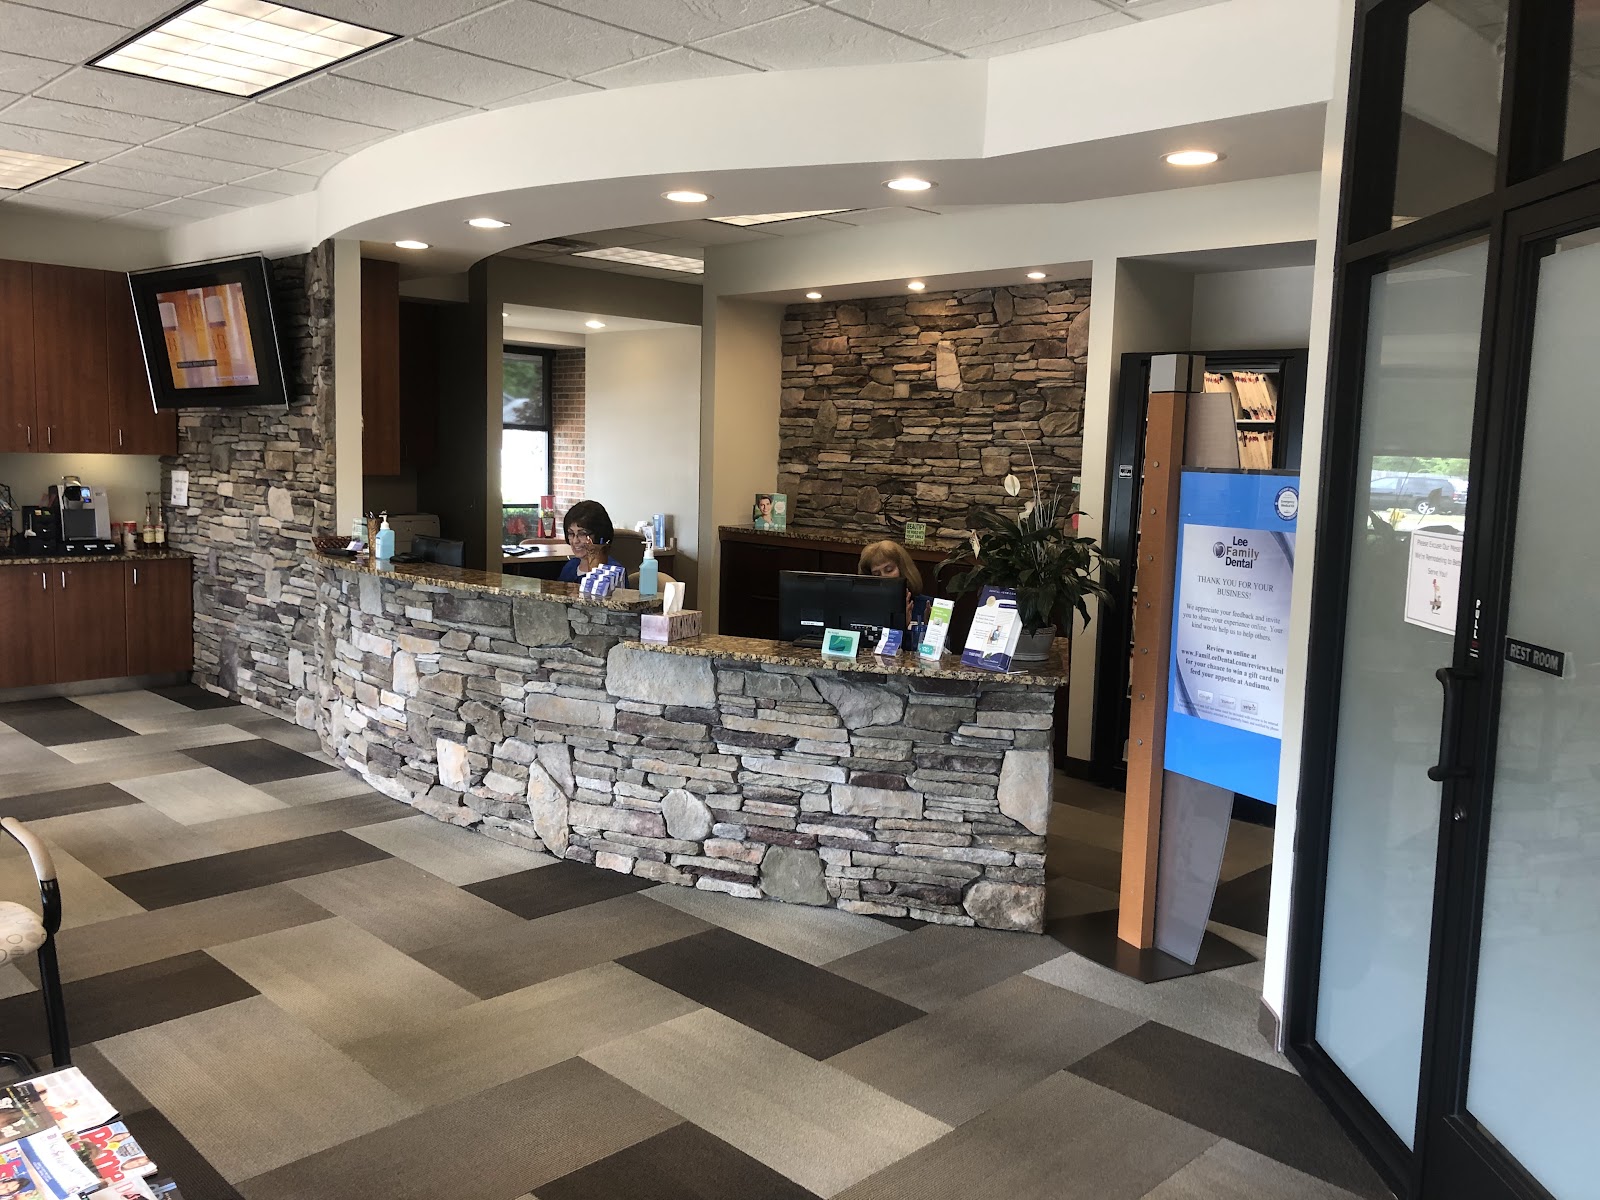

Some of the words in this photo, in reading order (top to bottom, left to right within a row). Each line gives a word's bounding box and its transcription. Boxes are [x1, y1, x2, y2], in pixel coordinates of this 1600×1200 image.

[1232, 536, 1248, 547] Lee
[1225, 557, 1253, 569] Dental
[1226, 546, 1260, 561] Family
[1197, 575, 1222, 586] THANK
[1222, 578, 1237, 588] YOU
[1238, 580, 1252, 590] FOR
[1253, 582, 1274, 592] YOUR
[1217, 588, 1252, 600] BUSINESS!
[1182, 612, 1192, 620] you
[1198, 614, 1211, 622] share
[1211, 616, 1223, 624] your
[1223, 618, 1250, 628] experience
[1250, 622, 1269, 632] online.
[1269, 625, 1283, 634] Your
[1195, 605, 1219, 615] appreciate
[1219, 609, 1231, 617] your
[1232, 610, 1254, 620] feedback
[1265, 616, 1281, 624] invite
[1473, 599, 1481, 639] PULL
[1191, 621, 1203, 629] kind
[1203, 623, 1218, 632] words
[1218, 625, 1229, 635] help
[1242, 630, 1254, 639] help
[1254, 632, 1272, 641] others.
[1206, 644, 1225, 653] Review
[1233, 649, 1250, 659] online
[1510, 643, 1531, 662] REST
[1532, 650, 1559, 671] ROOM
[1190, 668, 1201, 676] feed
[1201, 671, 1214, 679] your
[1214, 674, 1237, 684] appetite
[1243, 680, 1271, 691] Andiamo.
[1194, 660, 1206, 668] your
[1206, 663, 1225, 673] chance
[1232, 668, 1243, 676] win
[1248, 670, 1258, 679] gift
[1259, 674, 1272, 682] card
